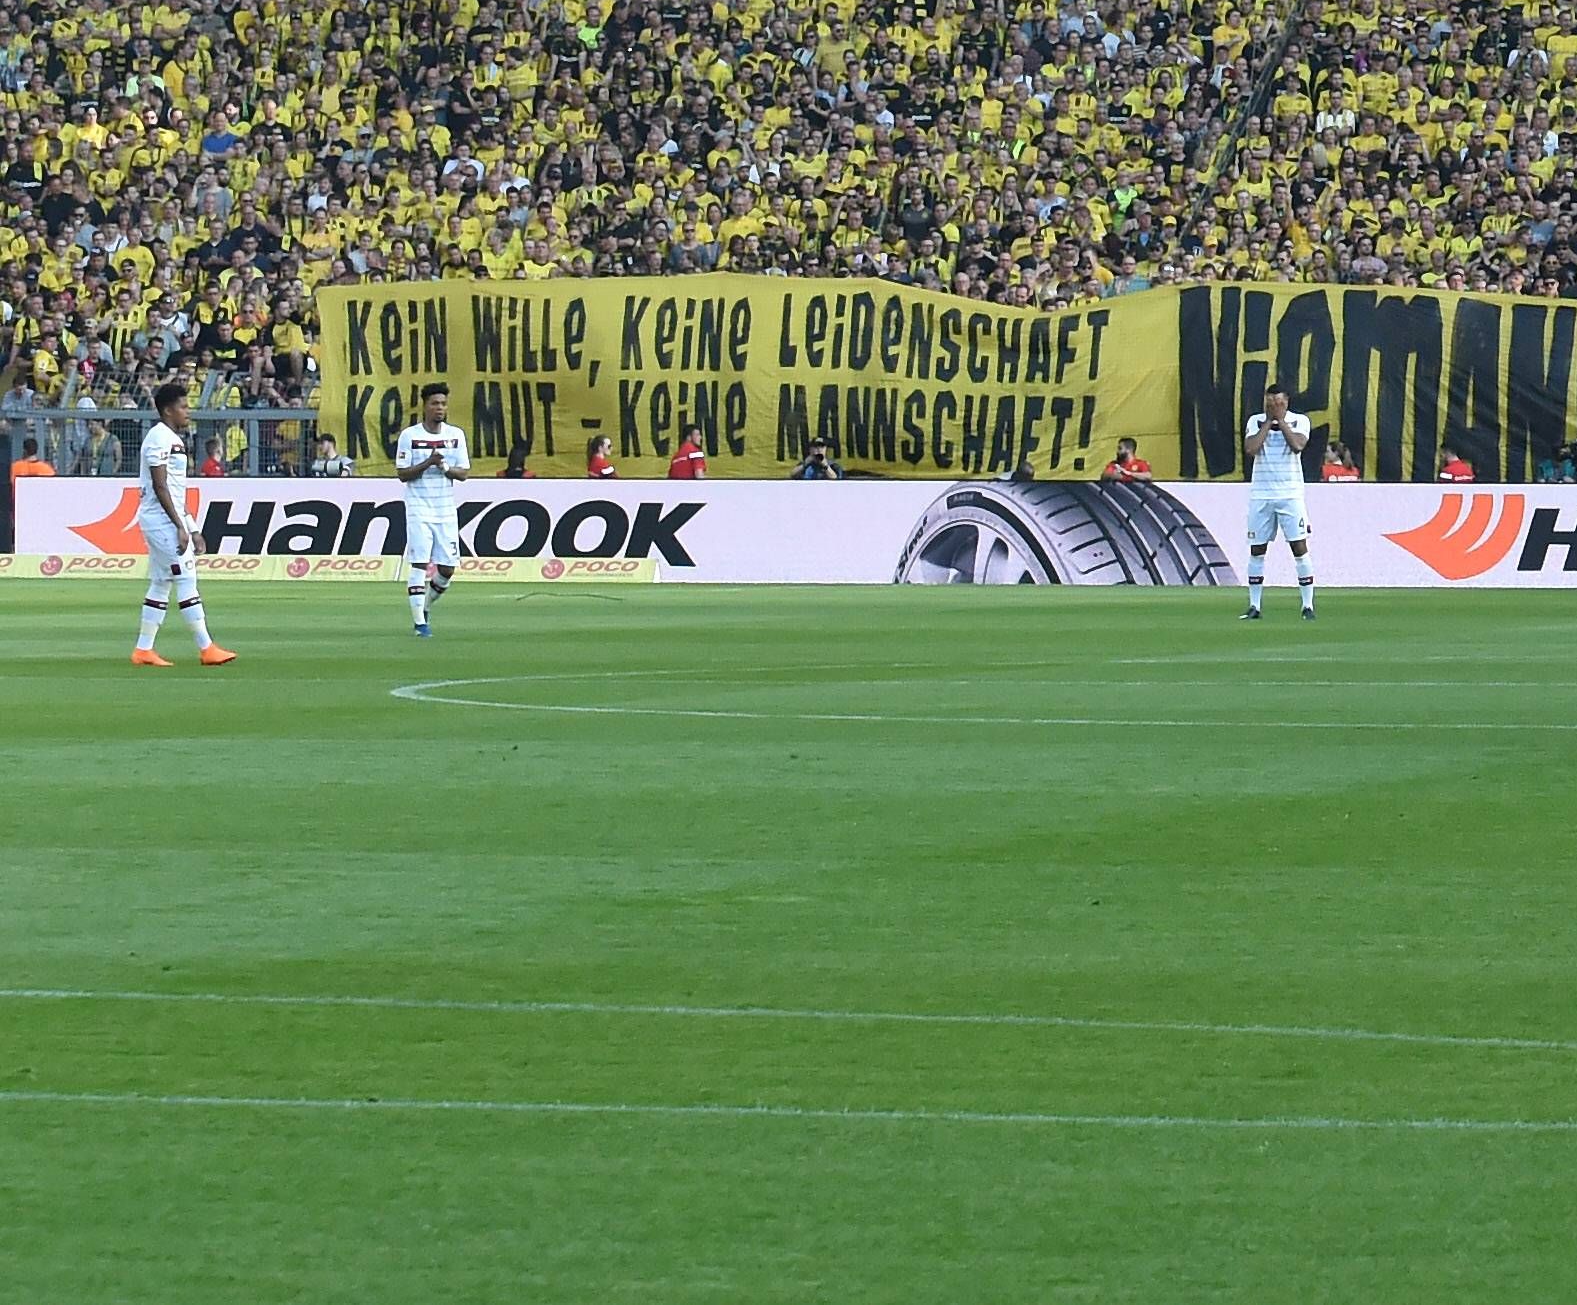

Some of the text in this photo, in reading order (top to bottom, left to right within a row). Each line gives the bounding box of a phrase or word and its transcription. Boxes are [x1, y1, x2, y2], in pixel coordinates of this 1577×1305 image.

[65, 557, 137, 570] POCO
[315, 558, 383, 571] POCO
[568, 560, 640, 572] POCO
